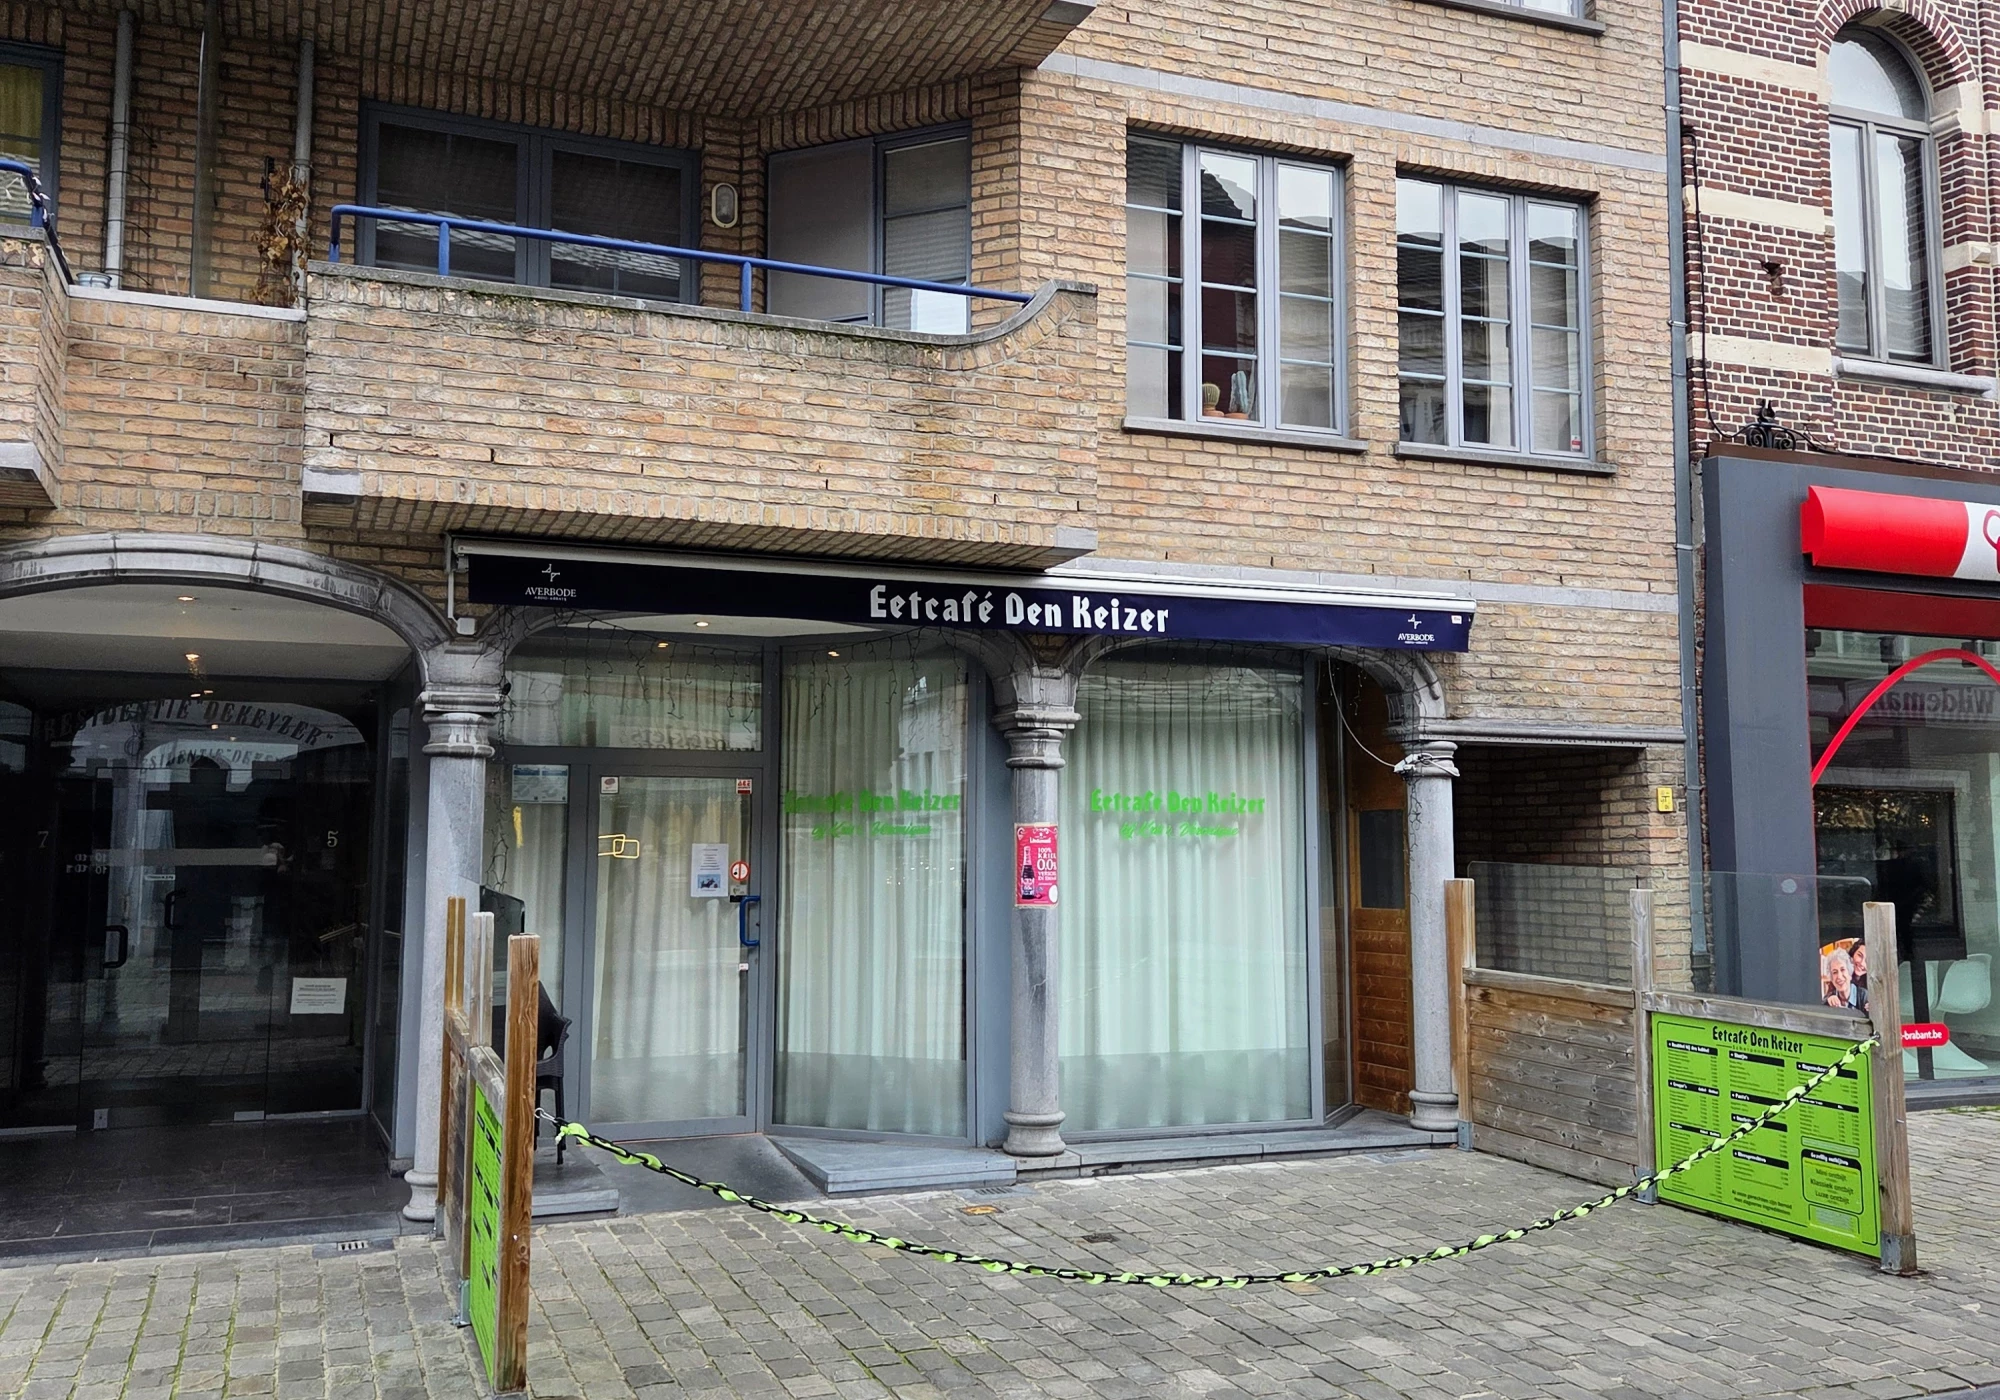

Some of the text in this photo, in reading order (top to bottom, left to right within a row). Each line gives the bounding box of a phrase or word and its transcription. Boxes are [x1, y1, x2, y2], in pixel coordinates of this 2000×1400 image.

[525, 586, 577, 598] AVERBODE
[870, 583, 1170, 634] Eetcafé Den Keizer
[1398, 632, 1436, 642] AVERBODE
[859, 788, 896, 812] Den
[899, 788, 961, 812] Keizer
[1167, 789, 1203, 814] Den
[1207, 791, 1266, 814] Keizer
[37, 830, 49, 850] 7
[326, 830, 339, 849] 5
[1712, 1025, 1804, 1054] Eetcafé Den Keizer
[1902, 1029, 1943, 1041] -brabant.be
